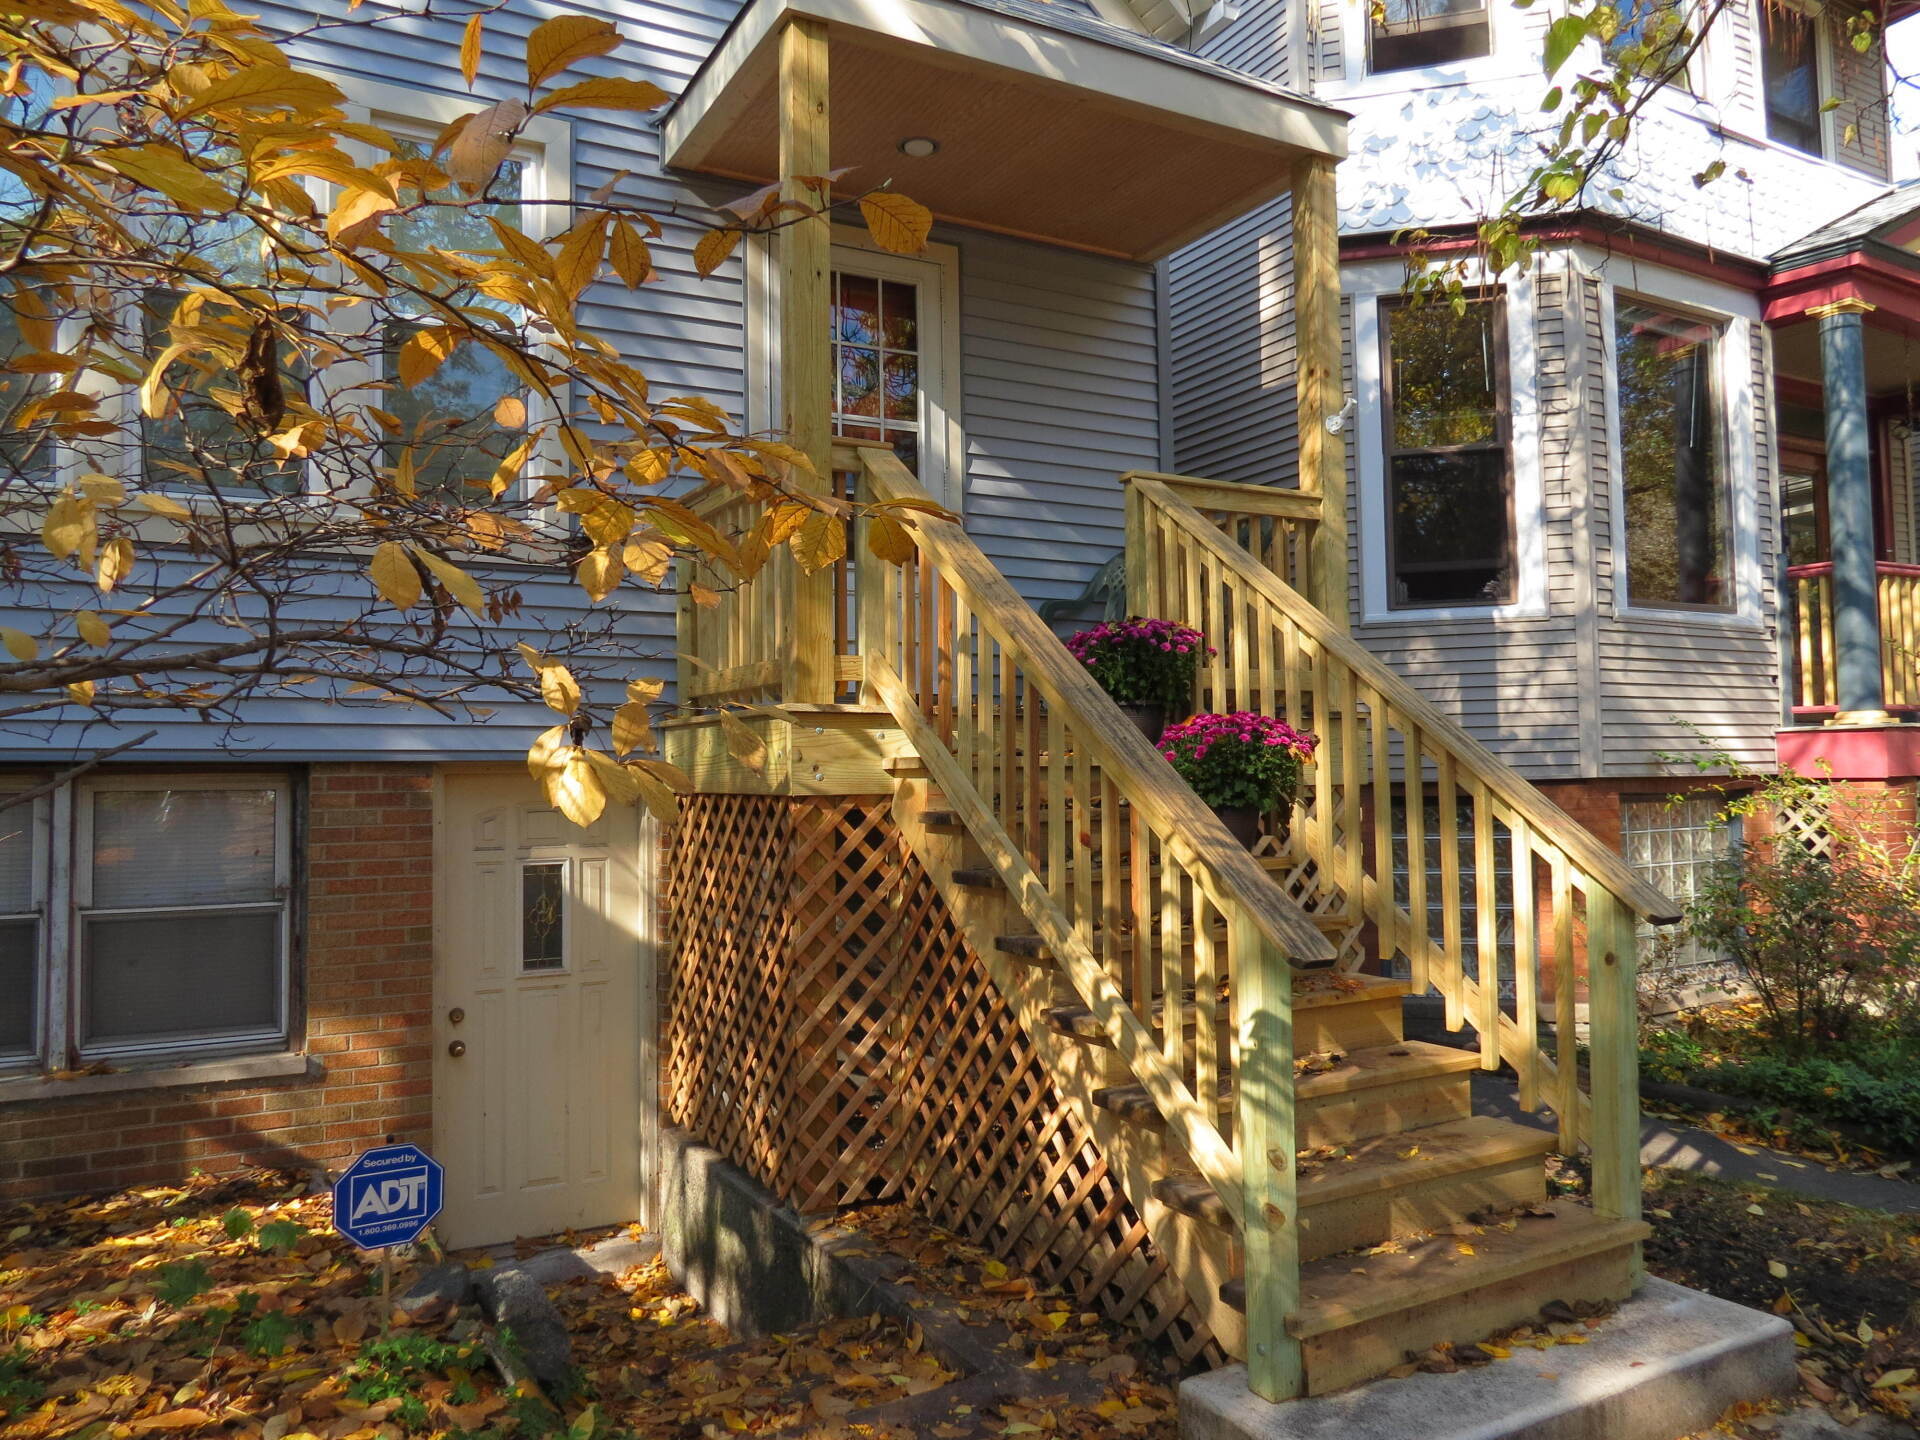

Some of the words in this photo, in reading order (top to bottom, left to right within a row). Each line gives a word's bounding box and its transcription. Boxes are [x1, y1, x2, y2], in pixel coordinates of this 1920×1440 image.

[363, 1155, 404, 1168] Secured
[405, 1153, 417, 1164] by
[352, 1175, 427, 1220] ADT
